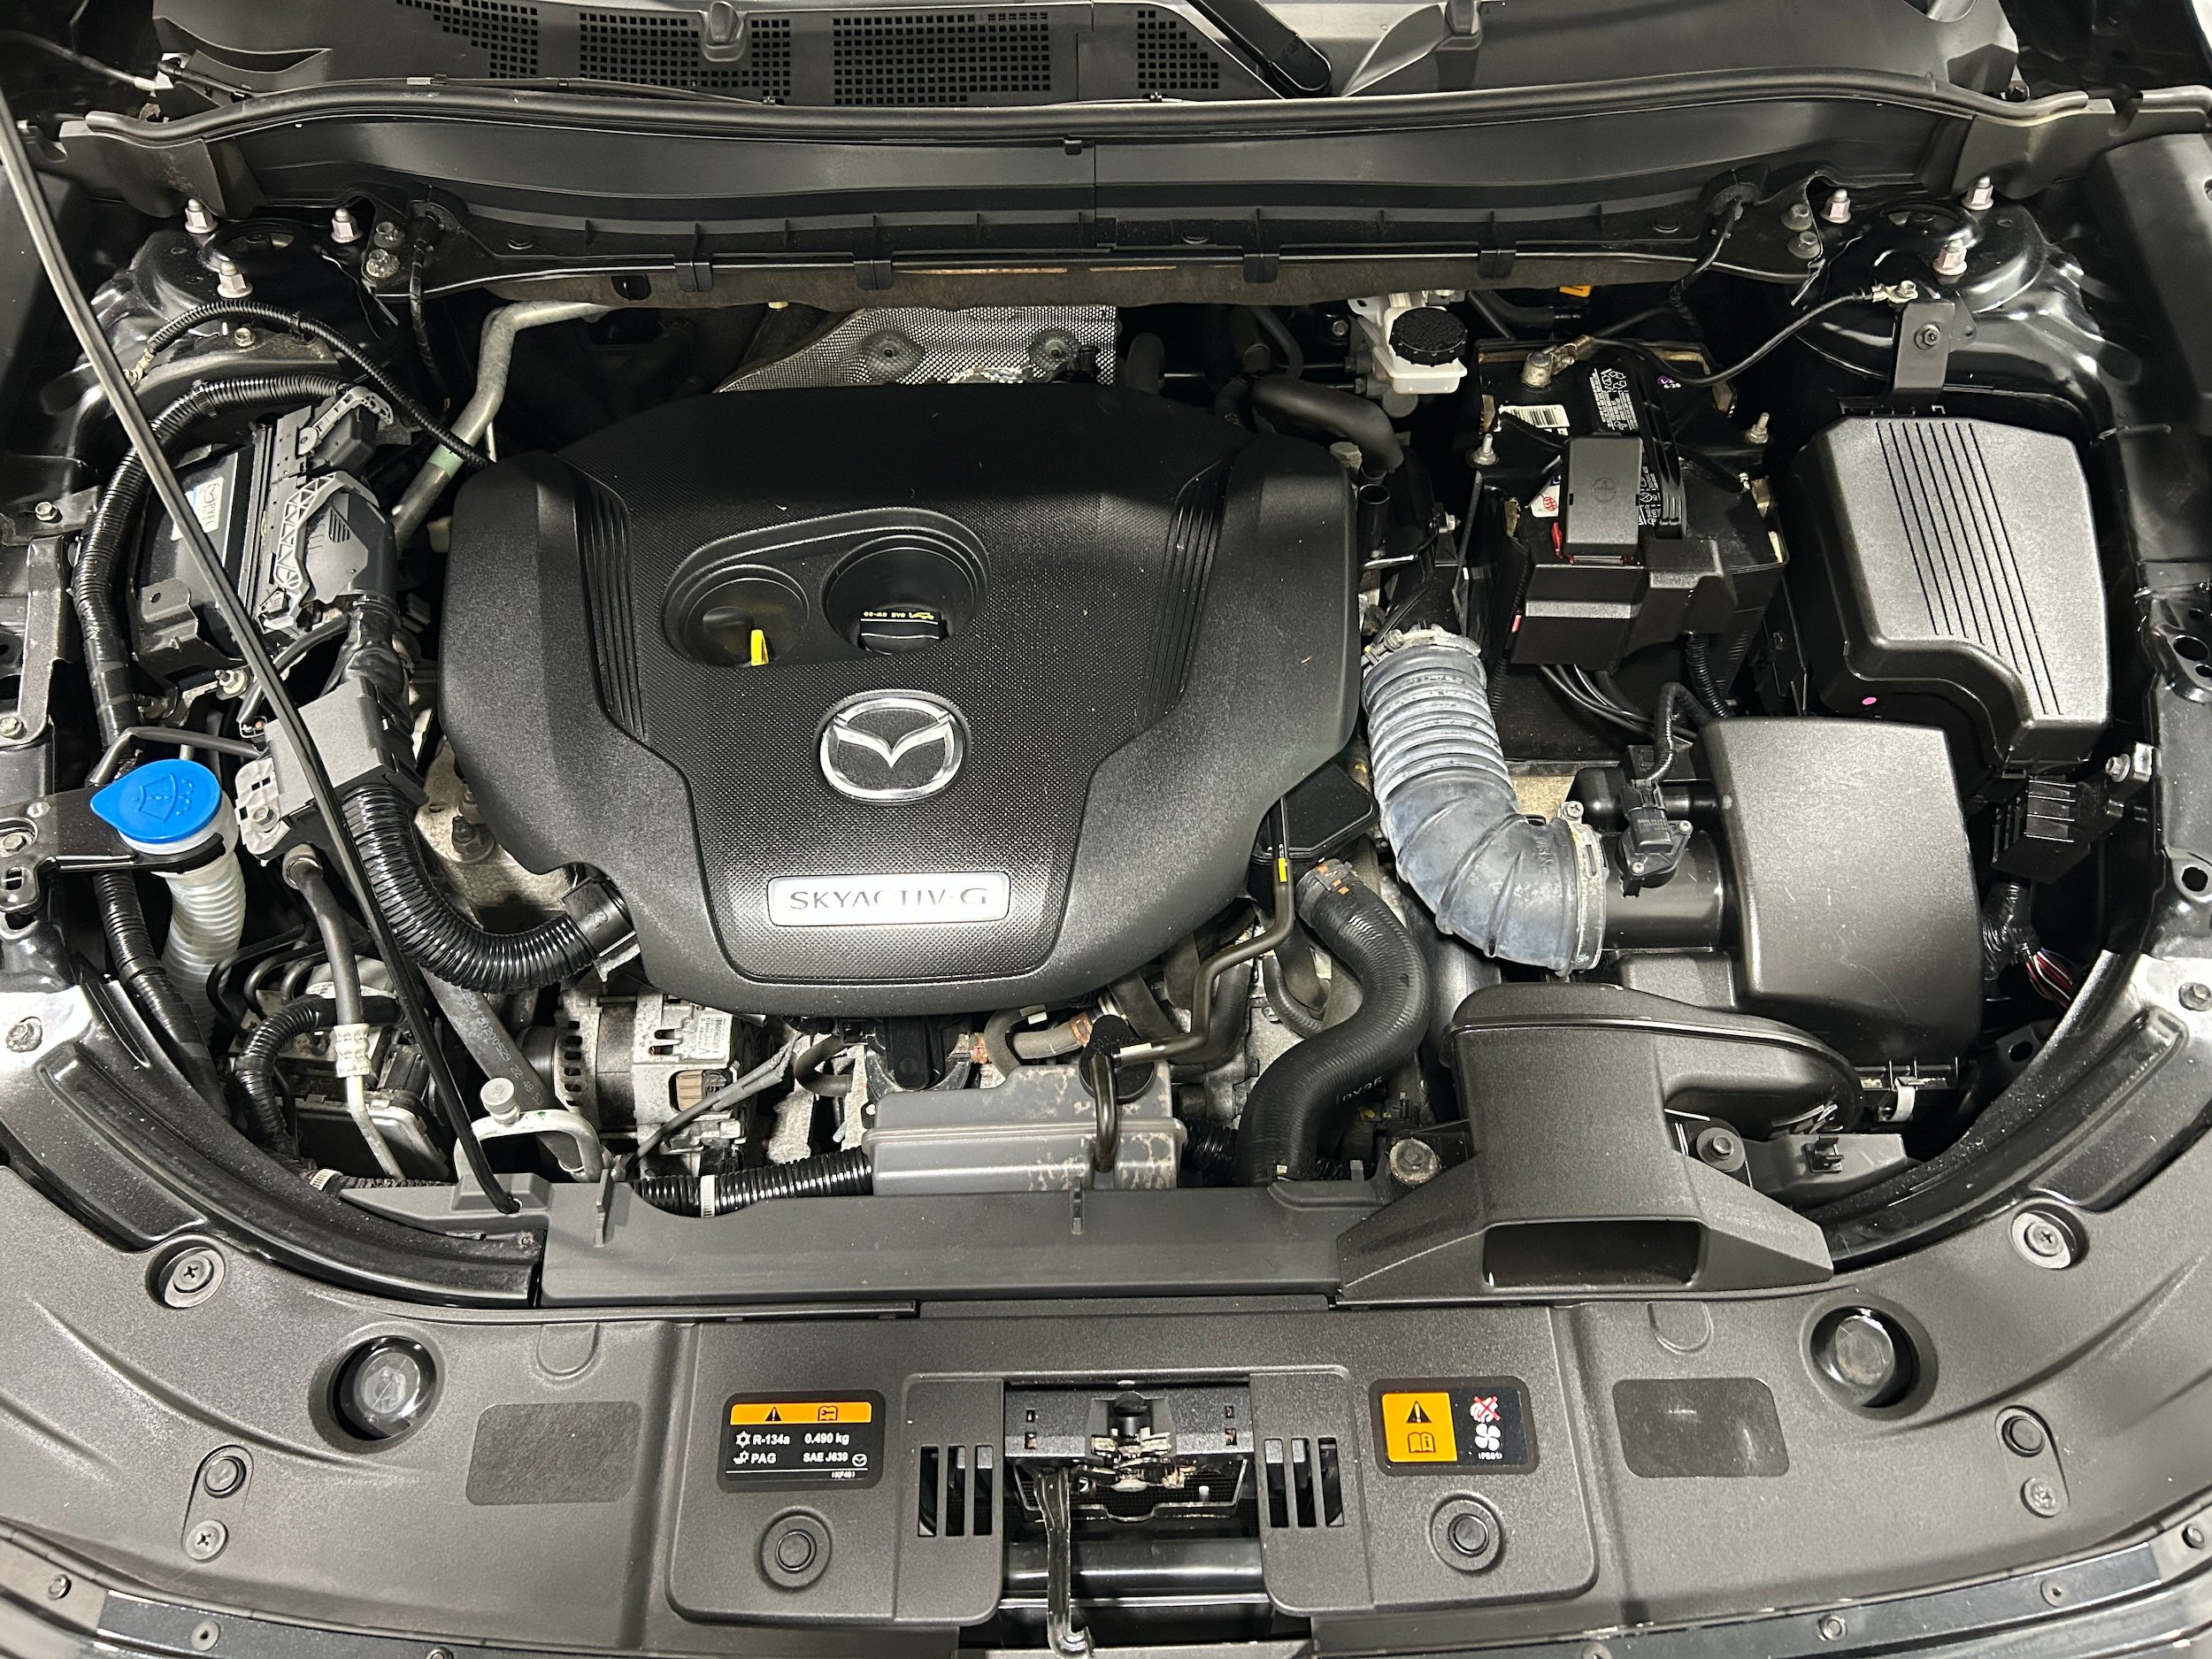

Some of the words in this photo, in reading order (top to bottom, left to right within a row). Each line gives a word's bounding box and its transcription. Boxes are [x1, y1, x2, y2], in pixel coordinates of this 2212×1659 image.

[753, 1433, 791, 1446] R-134a
[835, 1432, 850, 1446] kg
[751, 1453, 777, 1464] PAG
[803, 1452, 825, 1463] SAE
